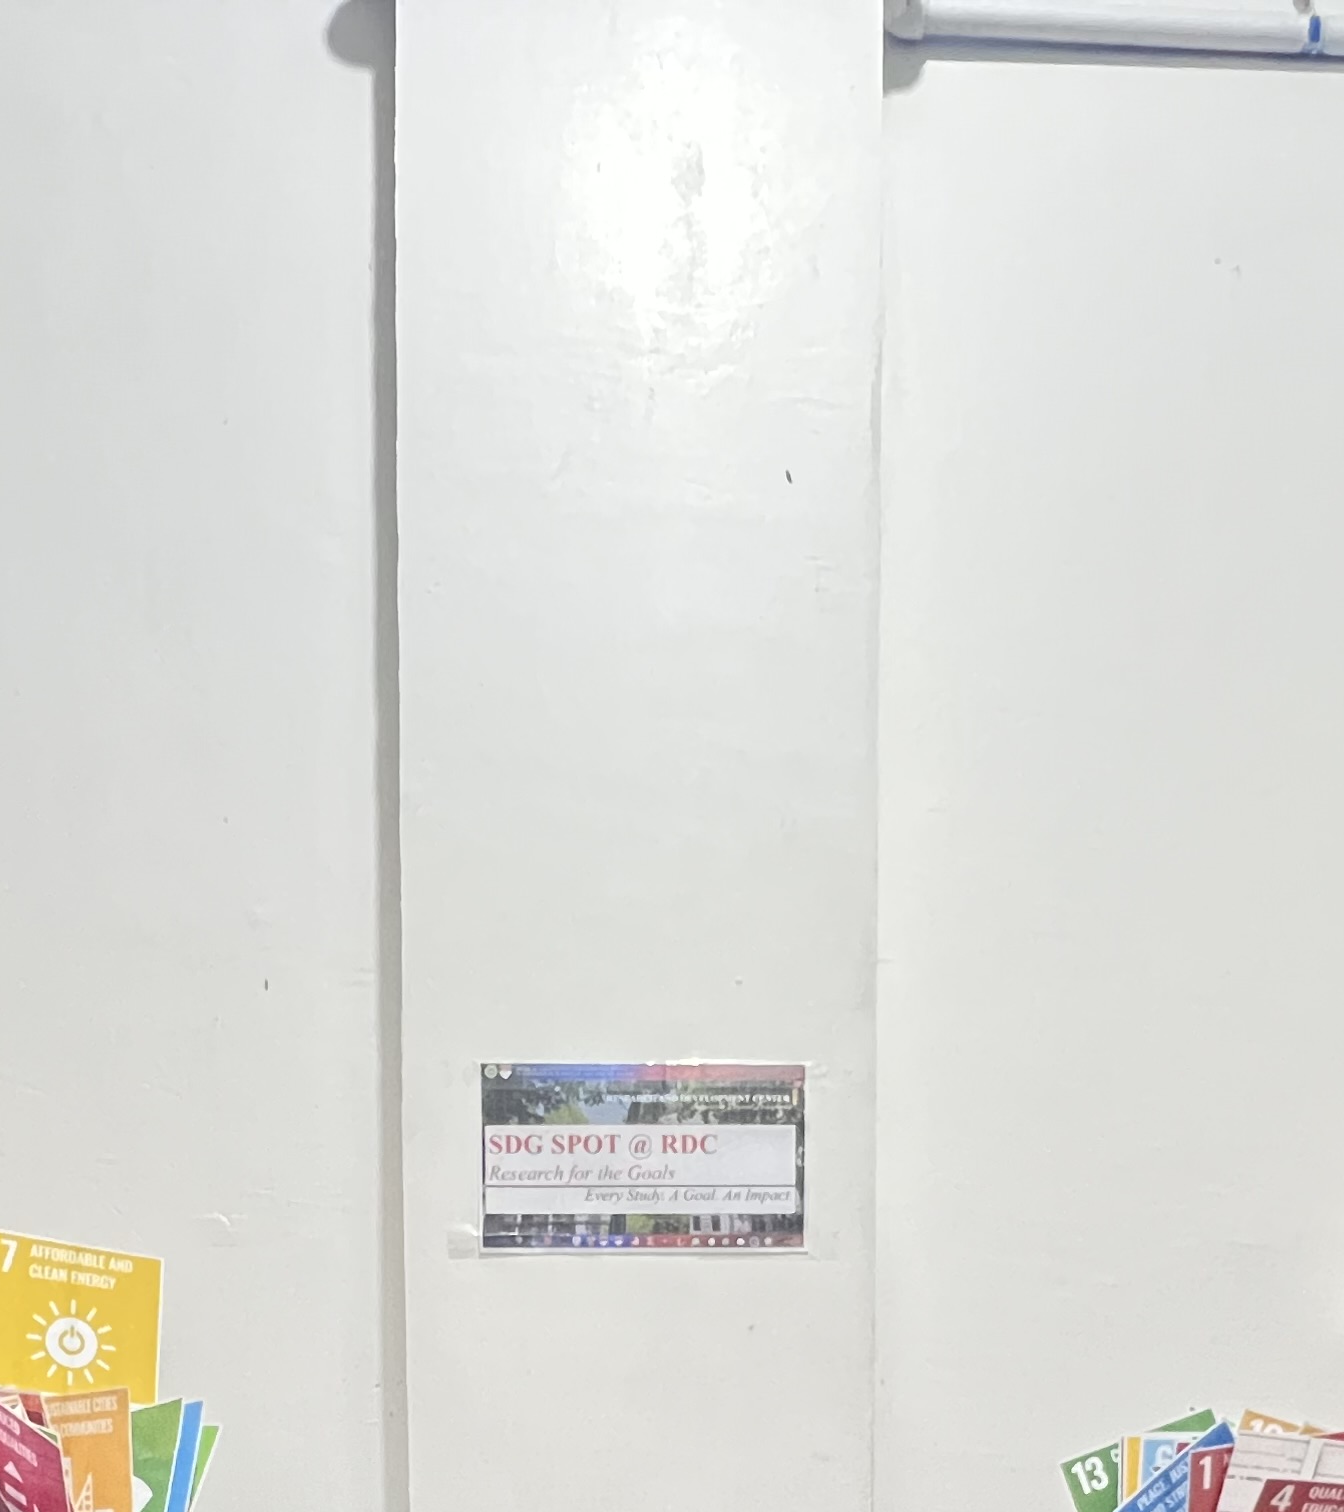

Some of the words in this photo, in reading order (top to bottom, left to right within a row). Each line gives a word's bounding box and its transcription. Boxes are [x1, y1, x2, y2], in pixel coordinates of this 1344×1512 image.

[488, 1134, 543, 1155] SDG
[551, 1134, 620, 1155] SPOT
[629, 1136, 652, 1159] @
[661, 1134, 717, 1155] RDC
[489, 1165, 563, 1181] Research
[568, 1165, 589, 1183] for
[595, 1165, 623, 1181] the
[628, 1165, 676, 1181] Goals
[585, 1189, 621, 1202] Every
[668, 1189, 678, 1201] A
[723, 1189, 741, 1201] An
[0, 1238, 17, 1273] 7
[30, 1243, 105, 1270] AFFORDABLE
[108, 1256, 133, 1273] AND
[29, 1264, 68, 1283] CLEAN
[71, 1268, 115, 1289] ENERGY
[1071, 1457, 1108, 1494] 13
[1199, 1456, 1212, 1489] 1
[1270, 1484, 1295, 1512] 4
